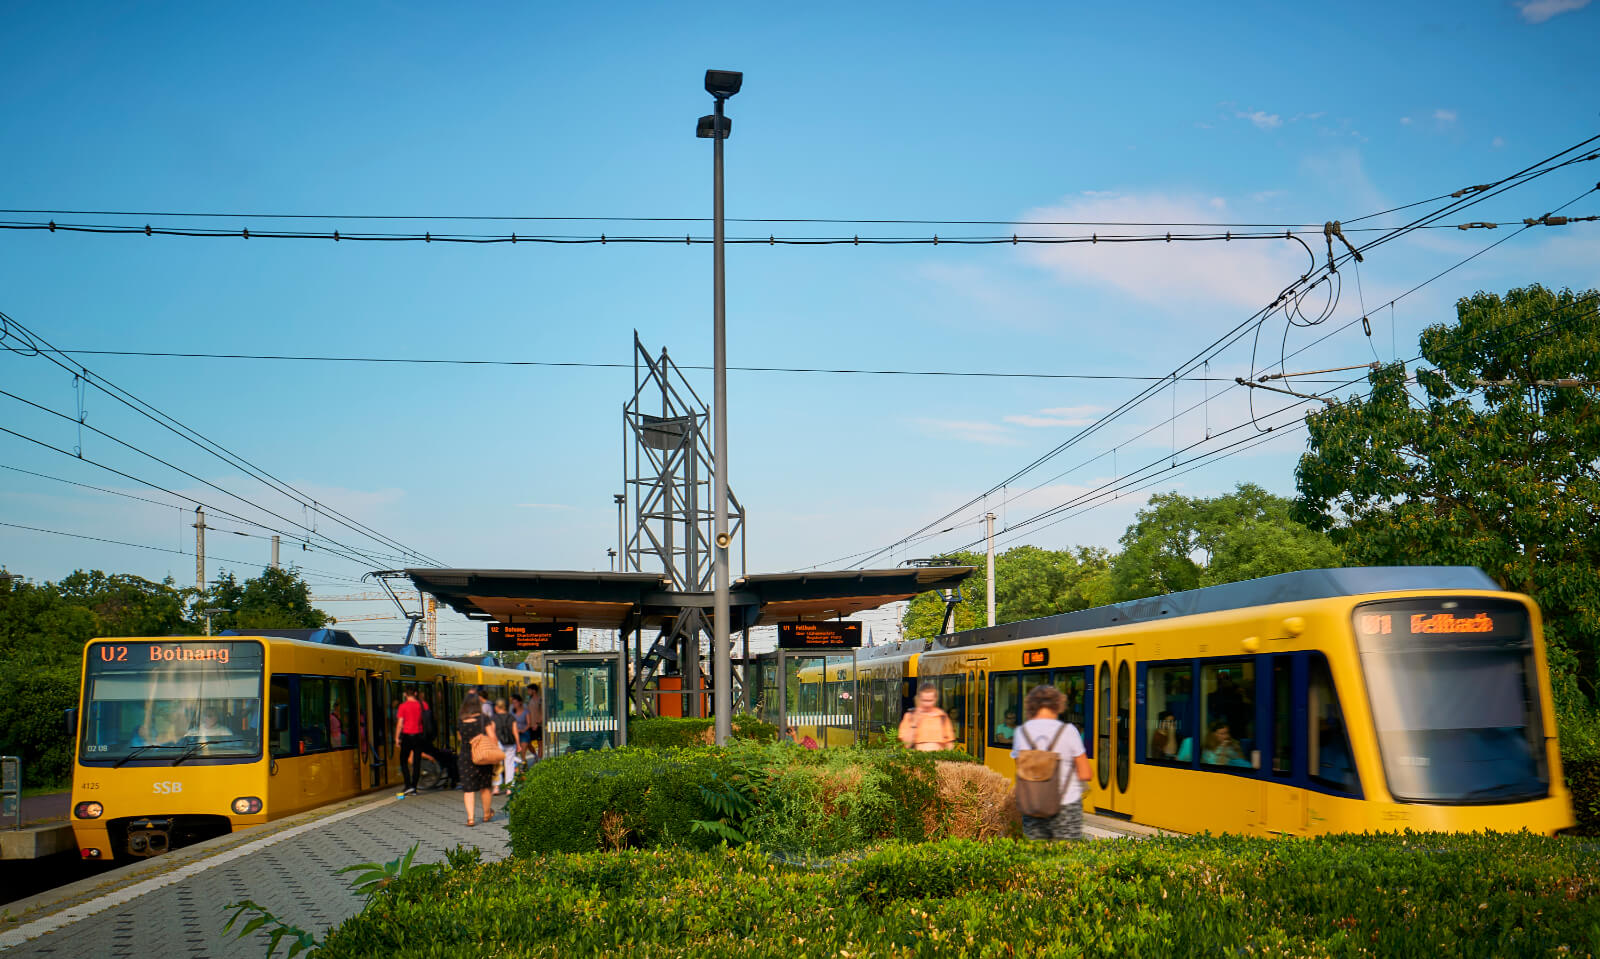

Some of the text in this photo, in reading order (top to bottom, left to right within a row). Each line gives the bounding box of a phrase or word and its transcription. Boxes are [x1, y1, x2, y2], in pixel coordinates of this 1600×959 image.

[100, 645, 230, 664] U2 Botnang
[81, 782, 100, 790] 4125
[152, 780, 183, 795] SSB
